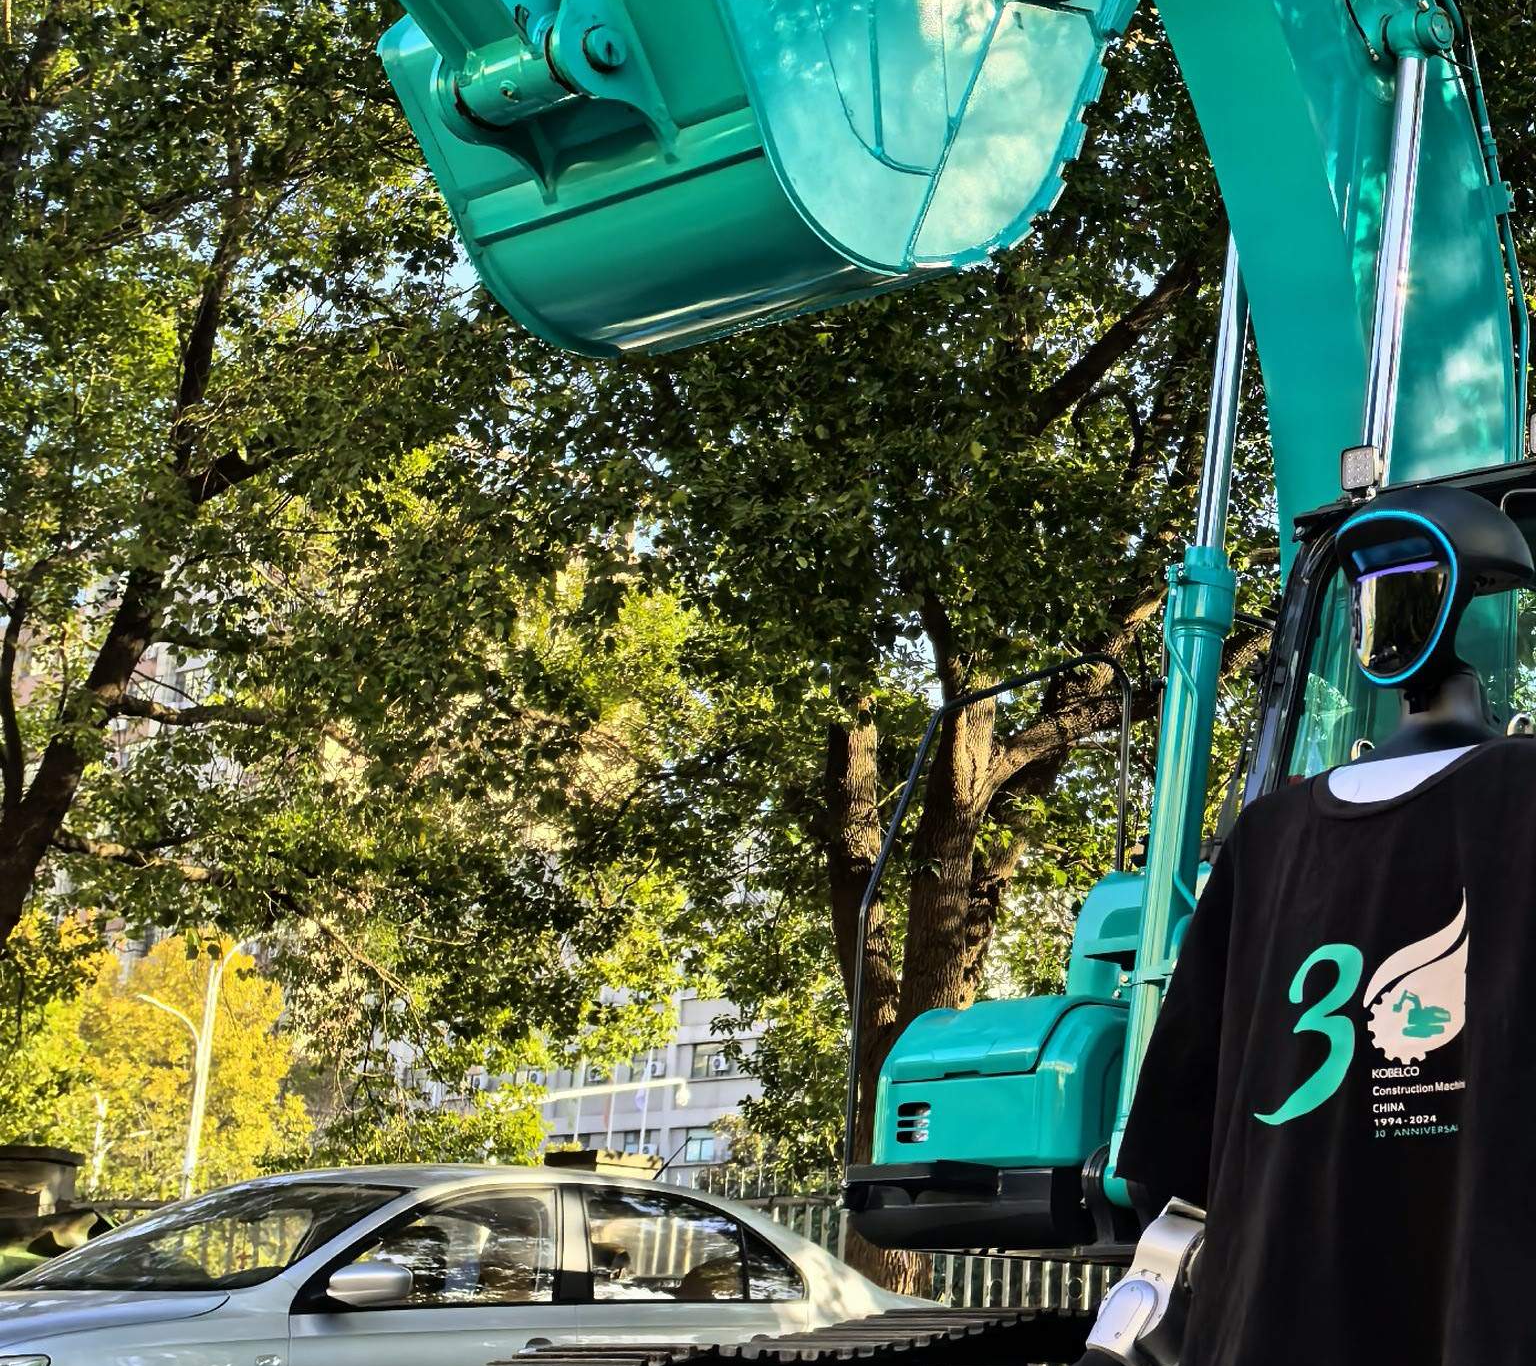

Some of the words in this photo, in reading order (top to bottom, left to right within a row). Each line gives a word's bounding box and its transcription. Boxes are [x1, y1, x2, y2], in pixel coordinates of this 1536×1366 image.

[1371, 1066, 1420, 1079] KOBELCO
[1372, 1084, 1434, 1097] Construction
[1372, 1102, 1405, 1113] CHINA
